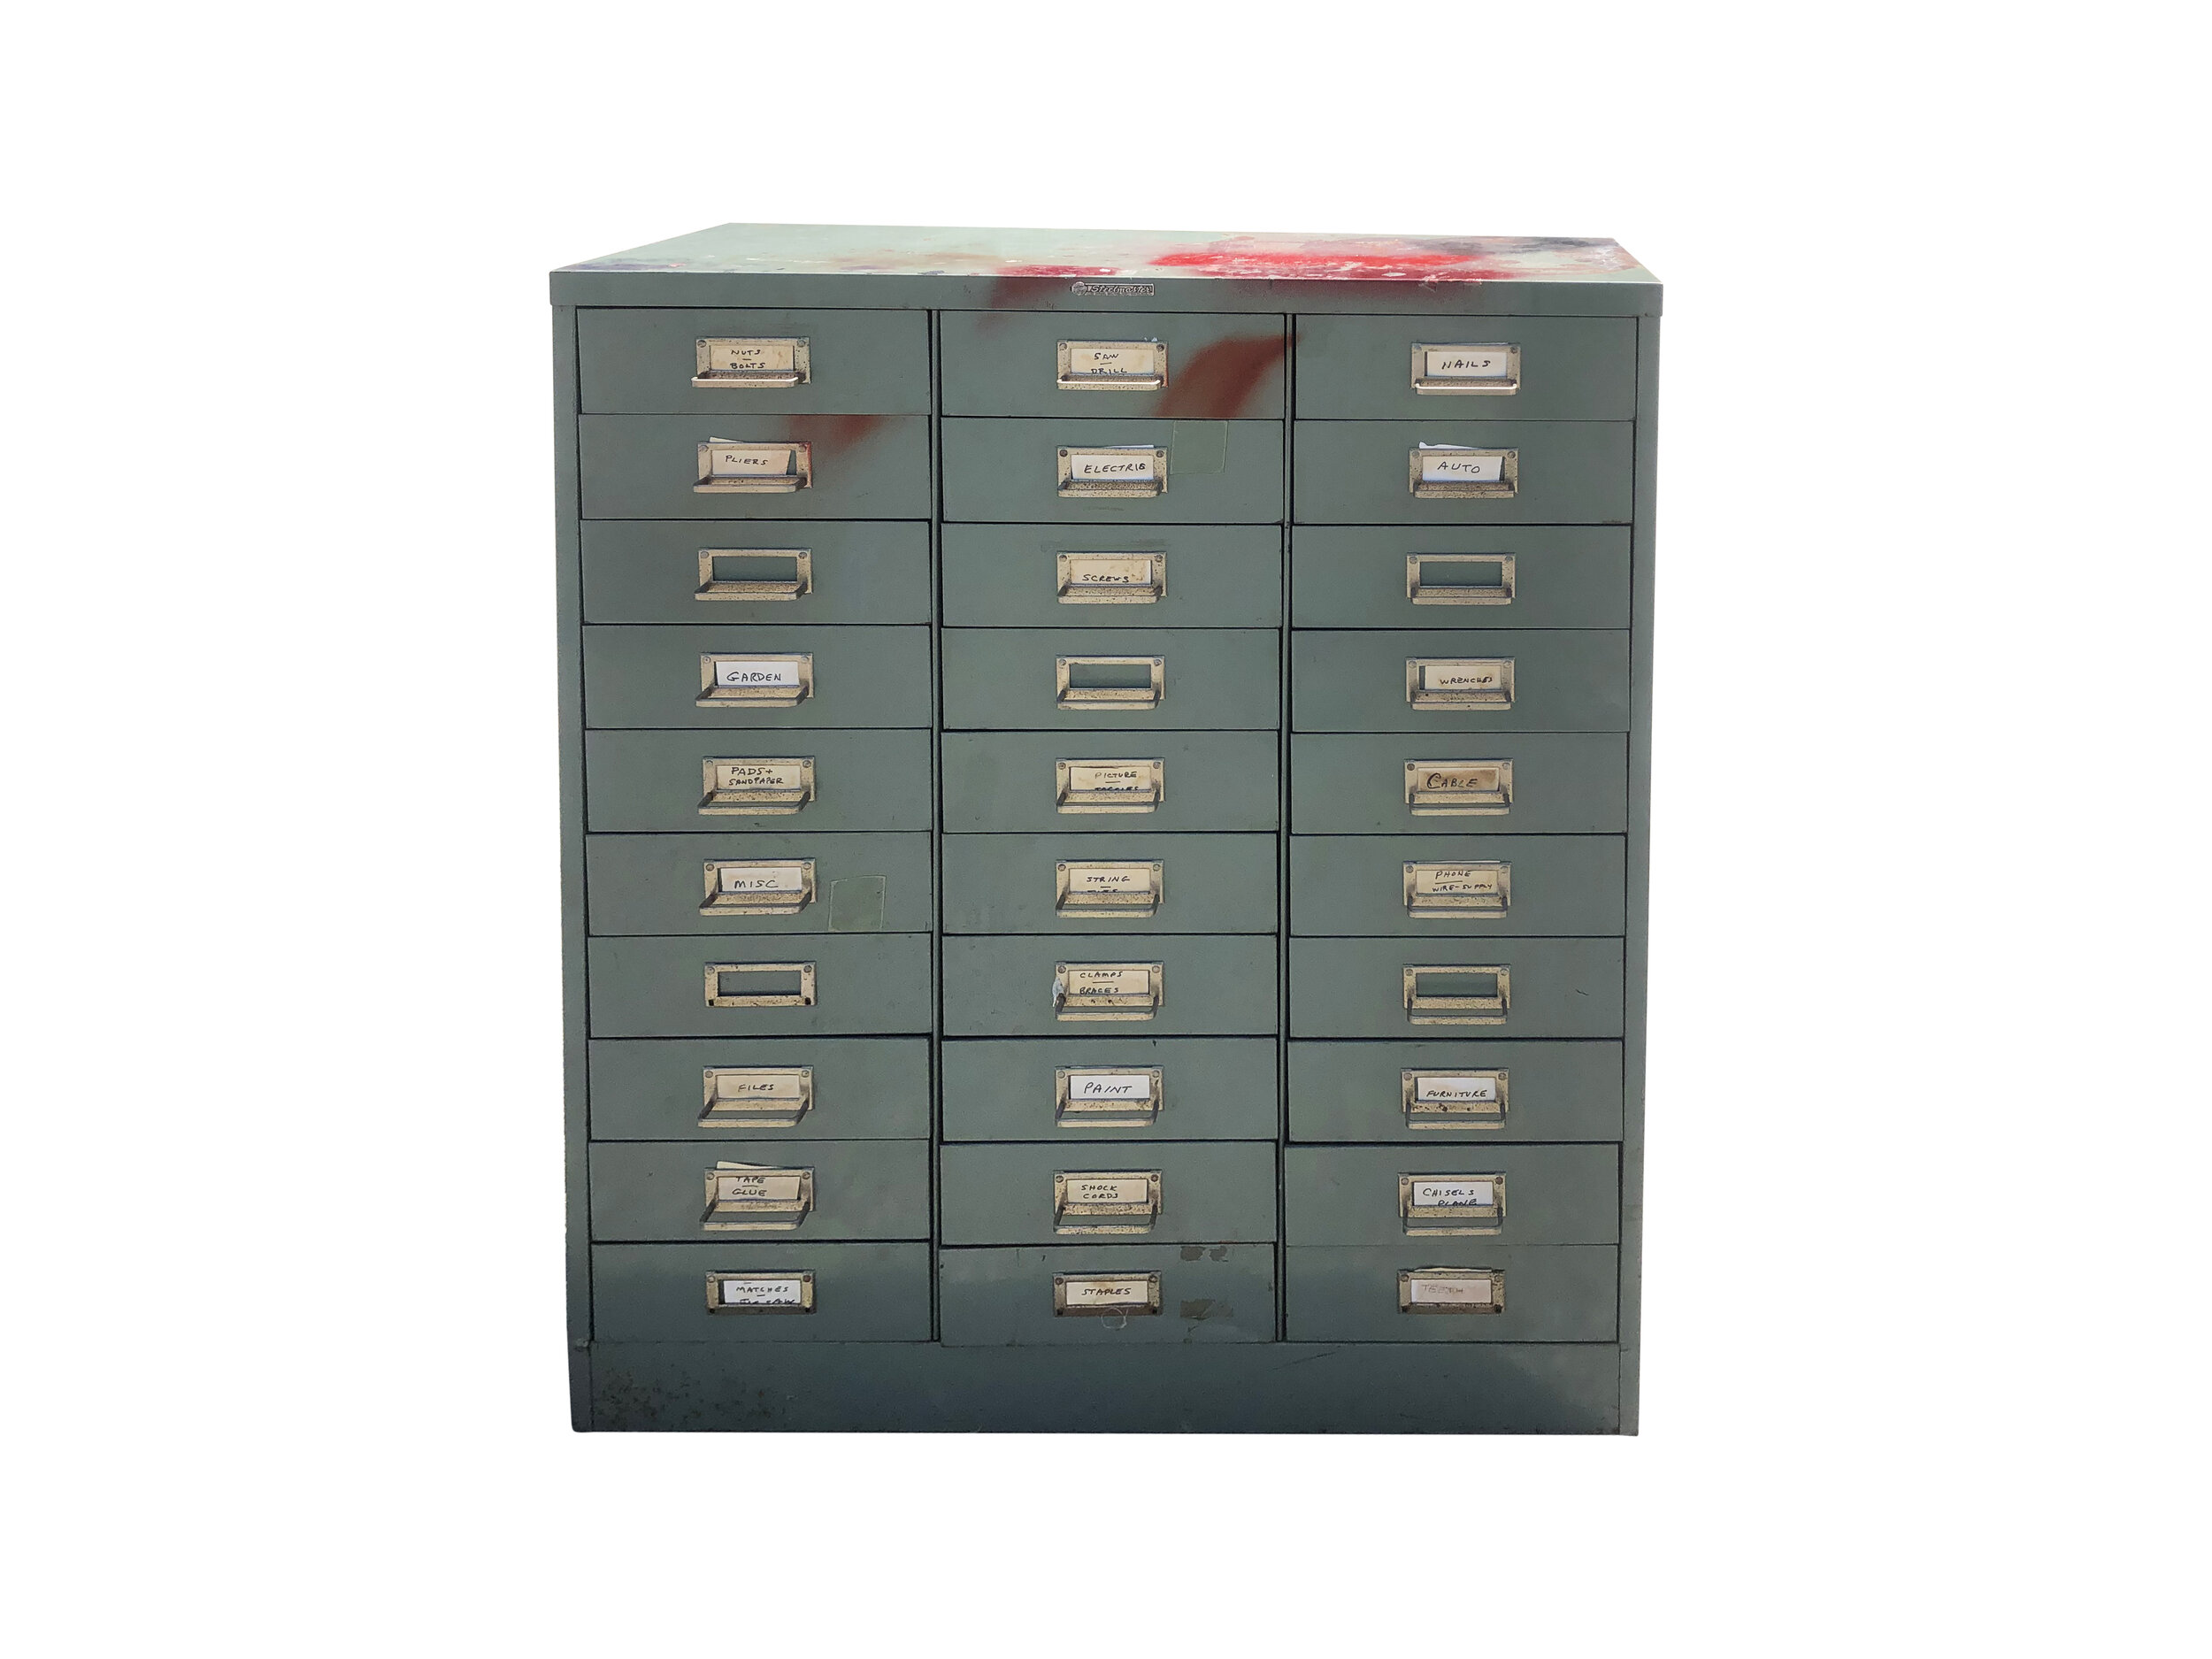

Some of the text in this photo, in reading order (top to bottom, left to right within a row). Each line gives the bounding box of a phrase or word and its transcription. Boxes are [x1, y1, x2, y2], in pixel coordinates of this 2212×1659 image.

[1093, 350, 1120, 360] SAW
[728, 361, 767, 370] BOLTS
[1440, 357, 1492, 370] NAILS
[725, 453, 770, 466] PLIERS
[1436, 459, 1481, 474] AUTO
[1080, 572, 1131, 583] SCREWS
[726, 670, 782, 683] GARDEN
[1440, 676, 1494, 685] WRENCHES
[1094, 771, 1138, 780] PICTURE
[728, 776, 785, 786] SANDPAPER
[1426, 772, 1479, 790] CABLE
[1086, 875, 1131, 884] STRING
[1434, 871, 1472, 880] PHONE
[734, 879, 780, 890] MISC
[1079, 971, 1124, 979] CLAMPS
[737, 1083, 775, 1092] FILES
[1083, 1081, 1133, 1094] PAINT
[1425, 1089, 1488, 1099] FURNITURE
[735, 1175, 766, 1184] TAPE
[731, 1187, 767, 1197] GLUE
[1421, 1187, 1476, 1197] CHISELS
[1080, 1288, 1133, 1297] STAPLES
